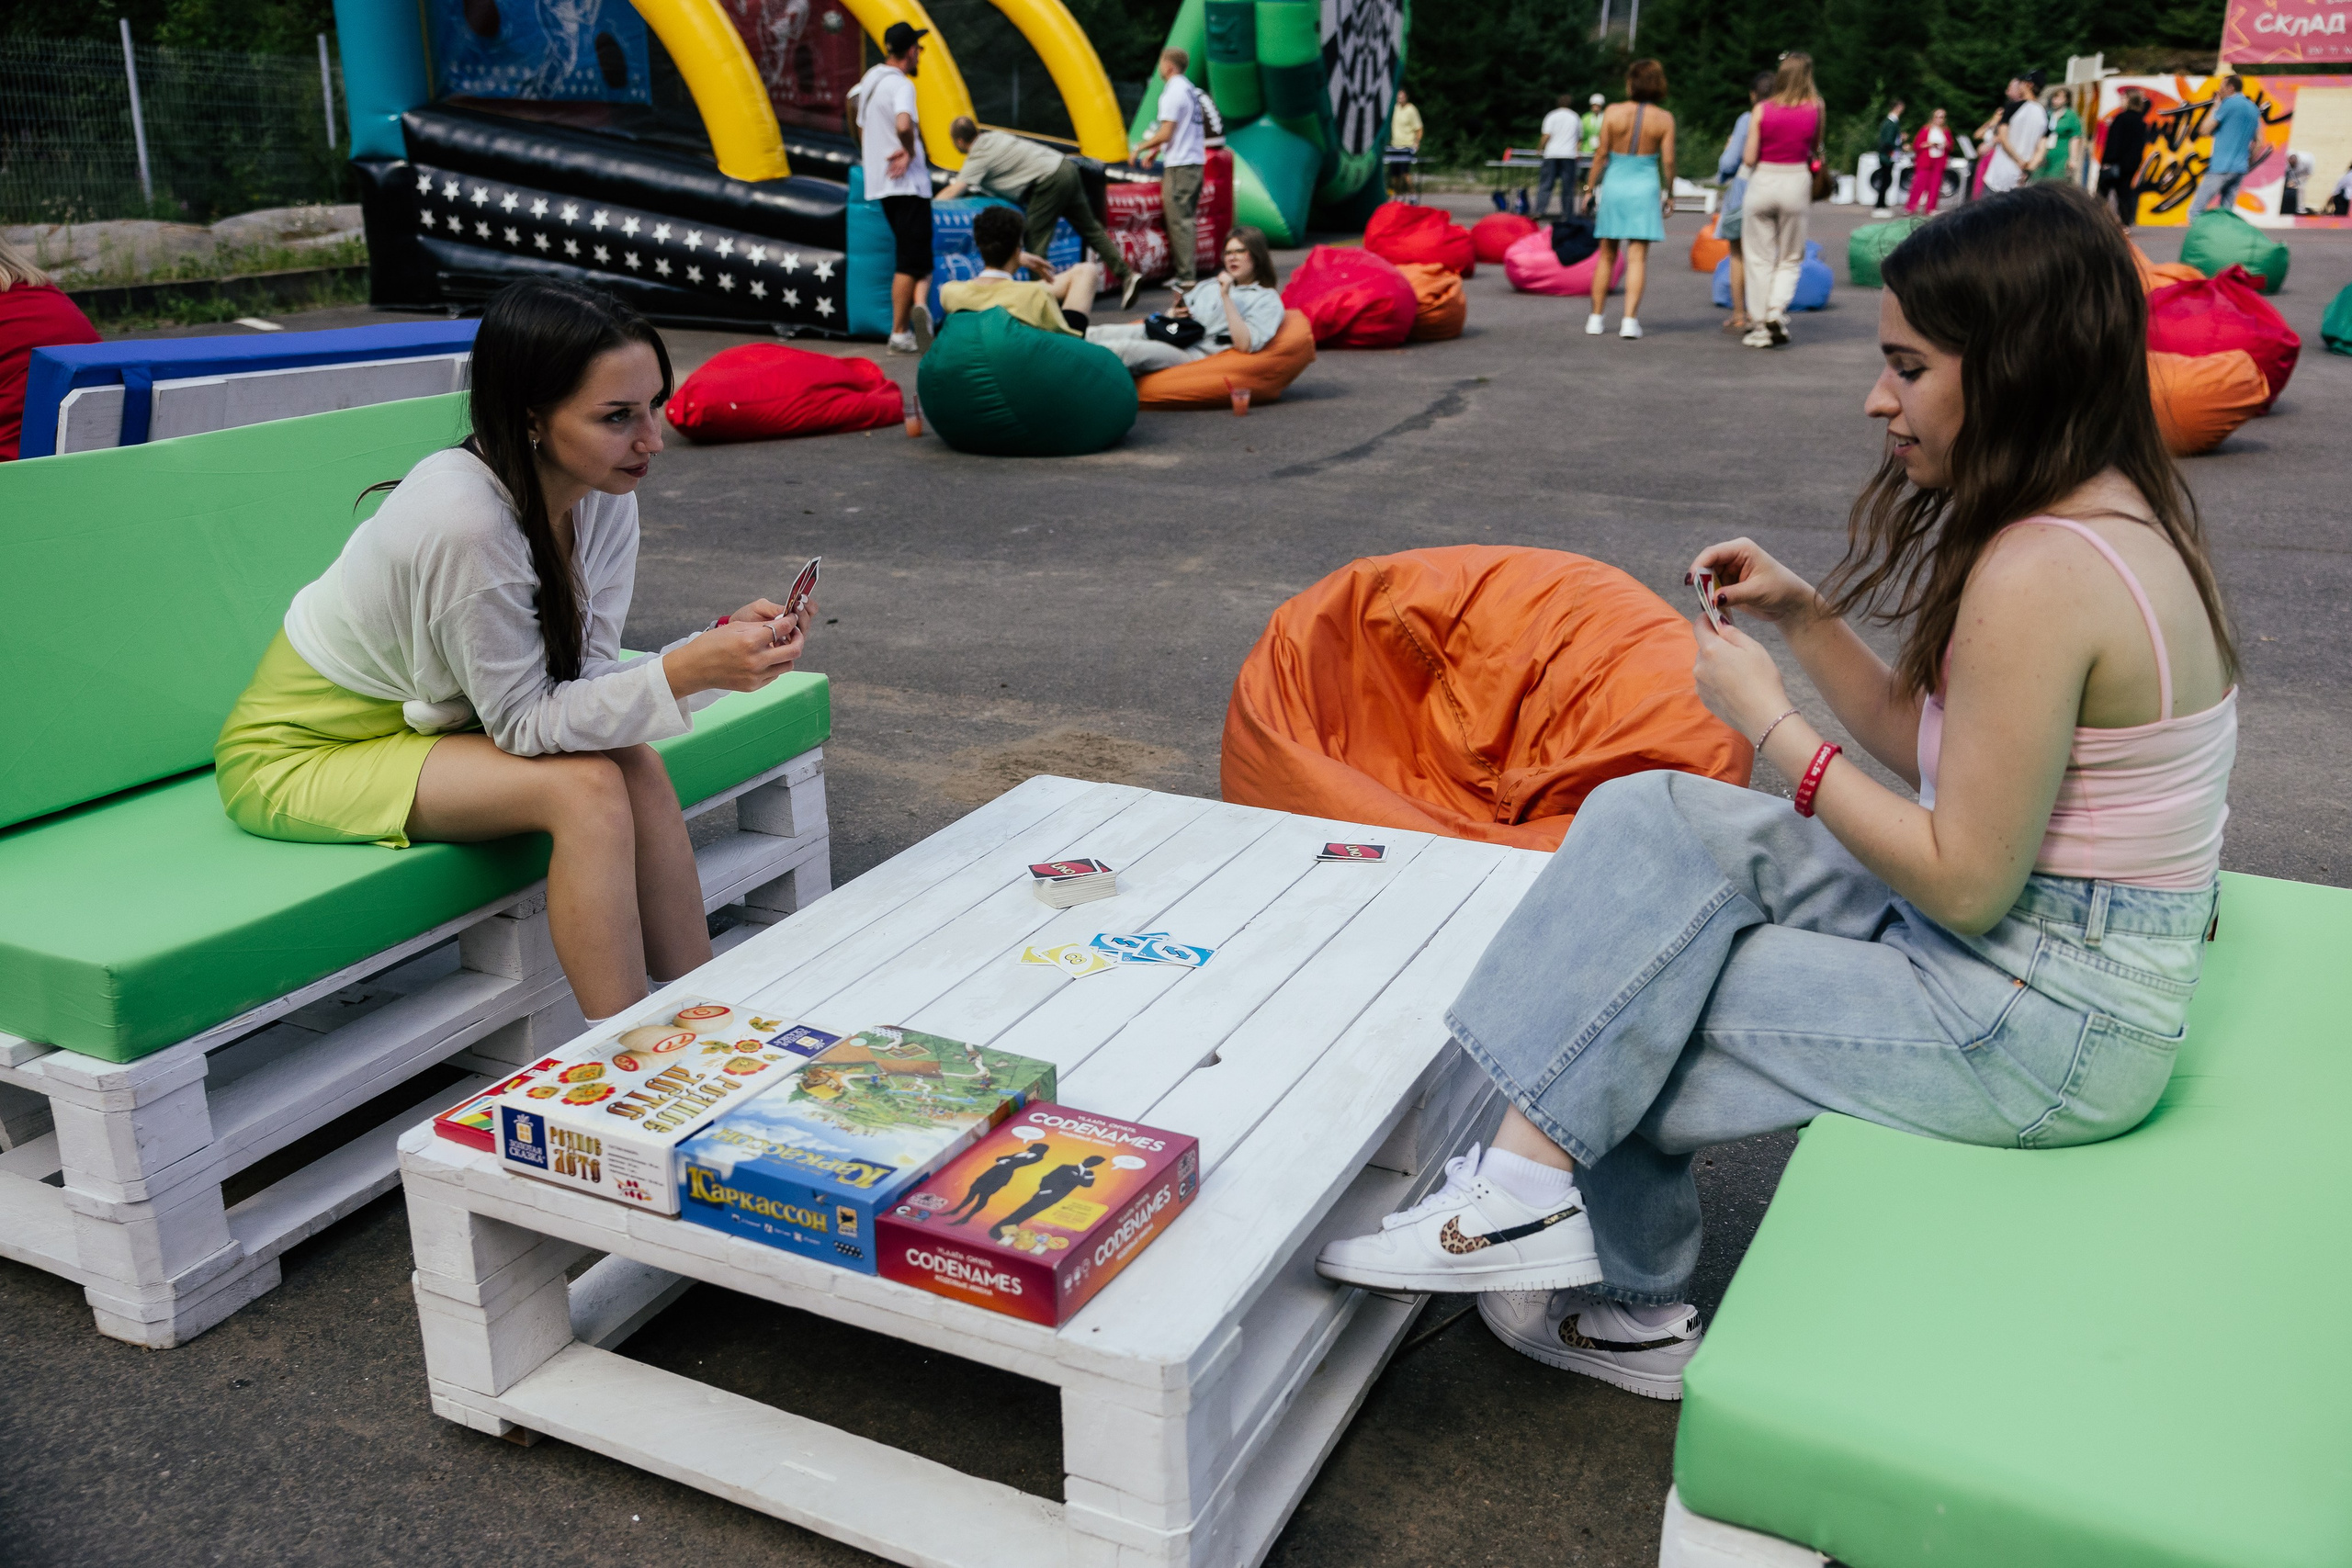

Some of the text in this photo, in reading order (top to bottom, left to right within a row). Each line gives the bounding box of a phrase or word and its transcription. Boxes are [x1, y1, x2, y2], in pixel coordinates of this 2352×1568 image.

[2253, 11, 2346, 37] СКЛАД
[1345, 845, 1363, 858] UNO
[1050, 863, 1076, 874] UNO
[1064, 953, 1088, 965] 8
[1027, 1111, 1167, 1153] CODENAMES
[1094, 1184, 1171, 1267] CODENAMES
[905, 1247, 1023, 1296] CODENAMES
[1685, 1314, 1701, 1333] NIK
